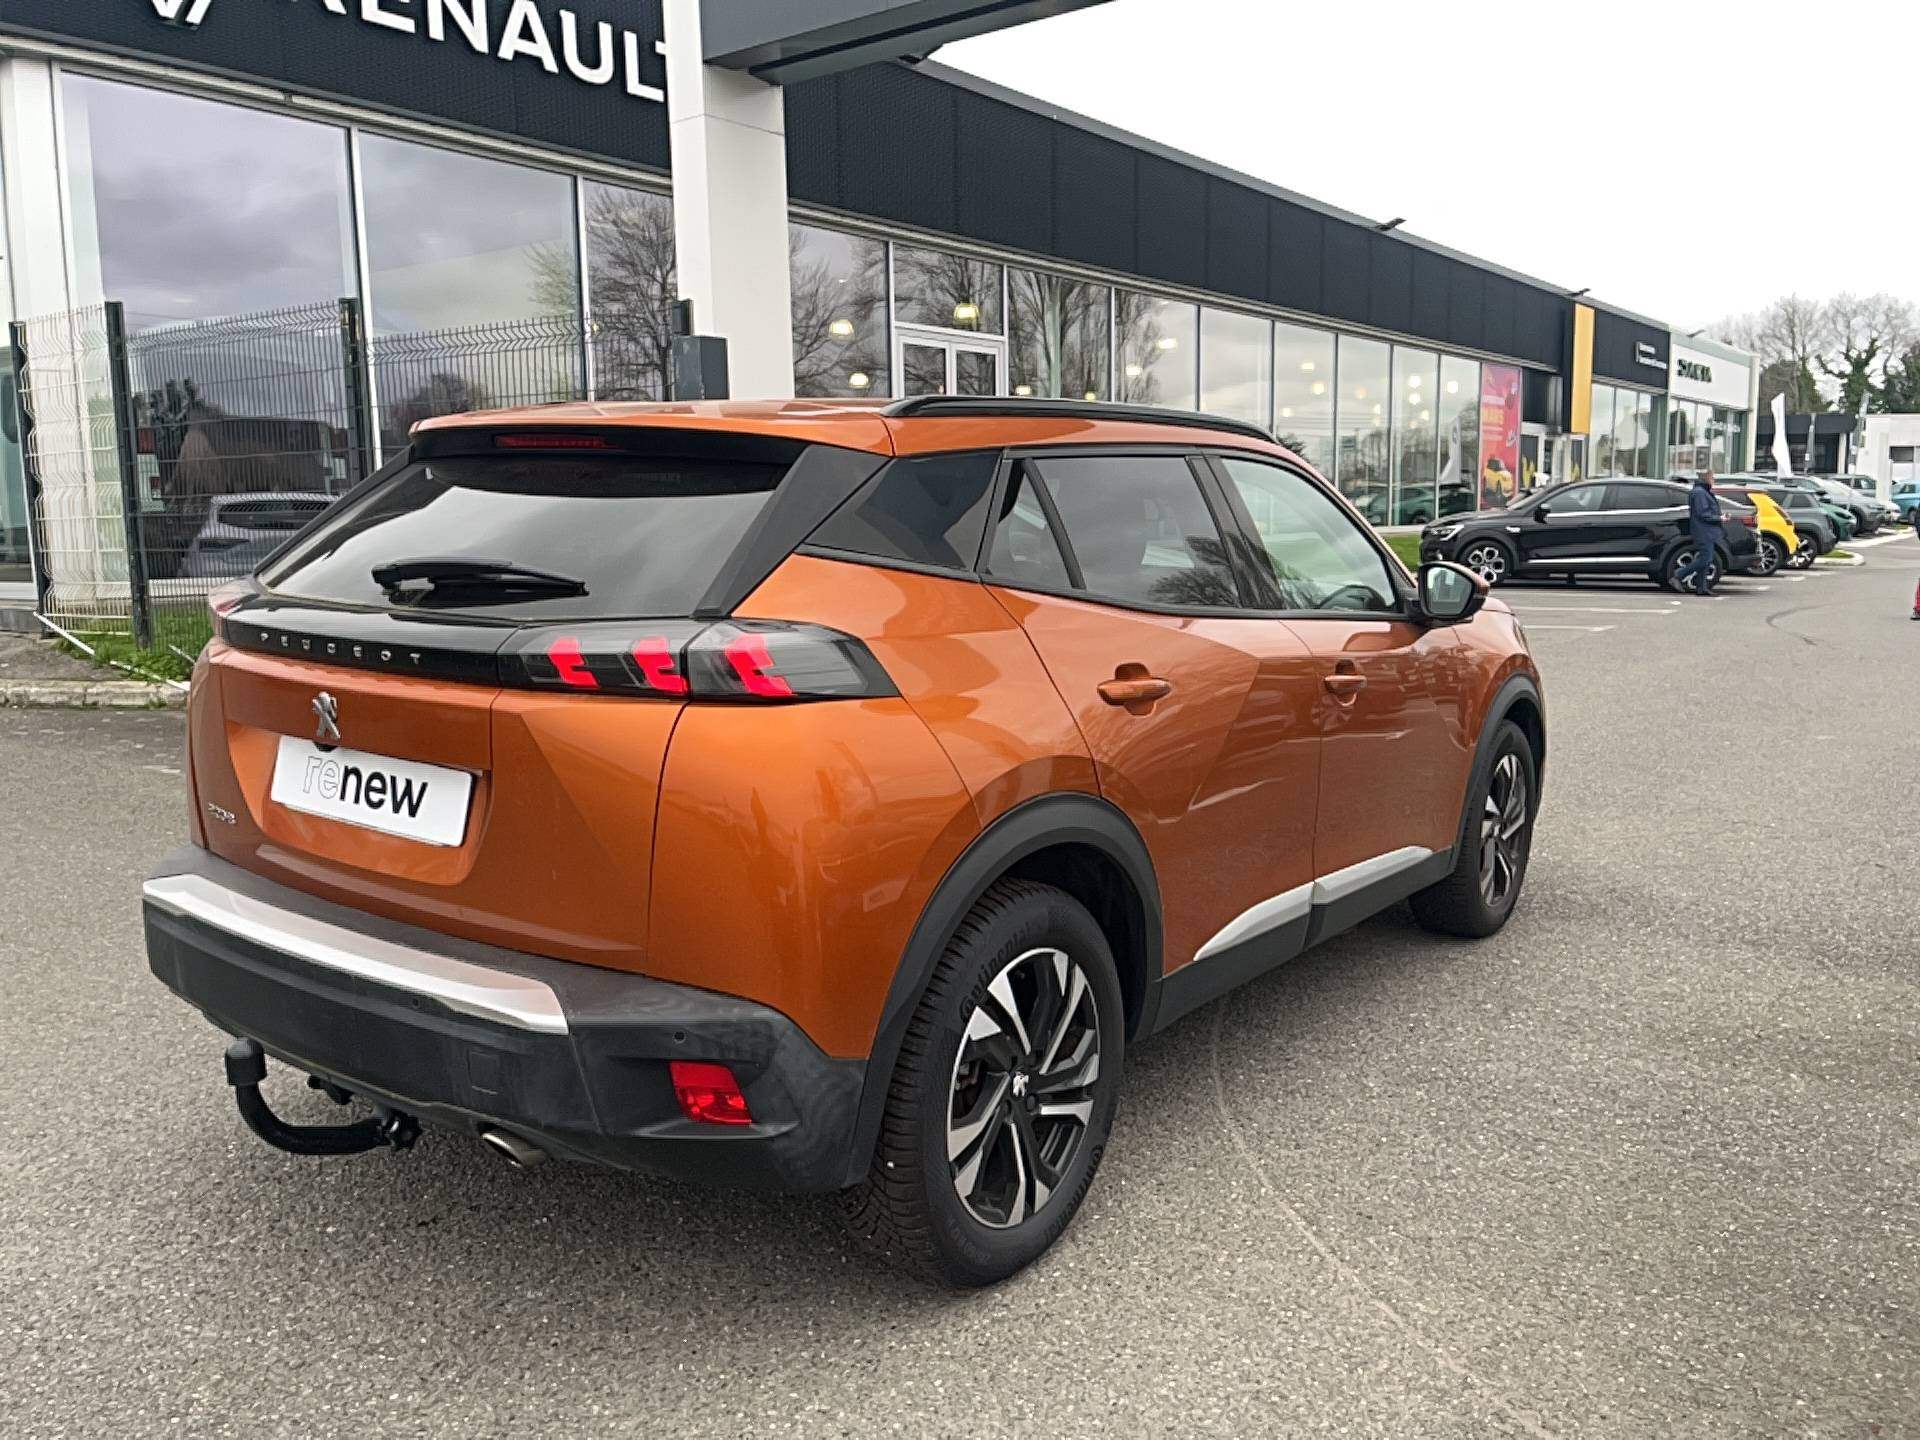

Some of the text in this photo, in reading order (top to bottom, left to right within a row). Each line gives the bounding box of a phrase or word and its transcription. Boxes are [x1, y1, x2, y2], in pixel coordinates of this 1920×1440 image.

[320, 0, 667, 102] NAUL
[260, 632, 421, 665] PEUGEOT
[303, 756, 429, 818] renew
